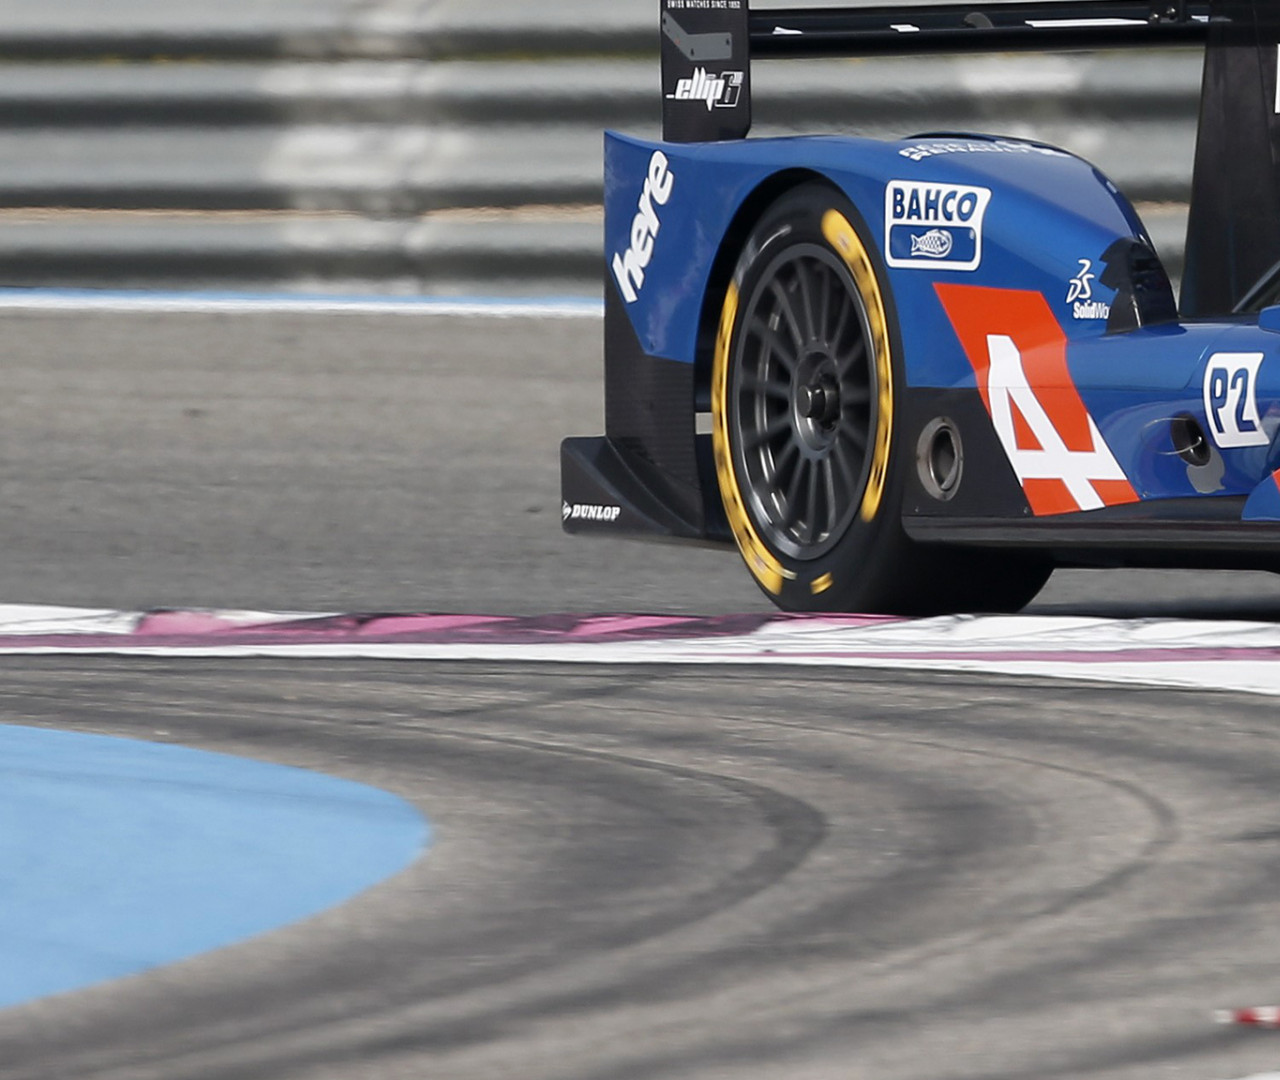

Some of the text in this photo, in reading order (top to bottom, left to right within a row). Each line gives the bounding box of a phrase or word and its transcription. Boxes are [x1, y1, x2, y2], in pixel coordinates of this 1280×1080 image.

[893, 187, 978, 222] BAHCO
[611, 150, 674, 304] here
[1073, 299, 1110, 319] SolidWo
[1209, 367, 1258, 434] P2
[570, 503, 621, 521] DUNLOP
